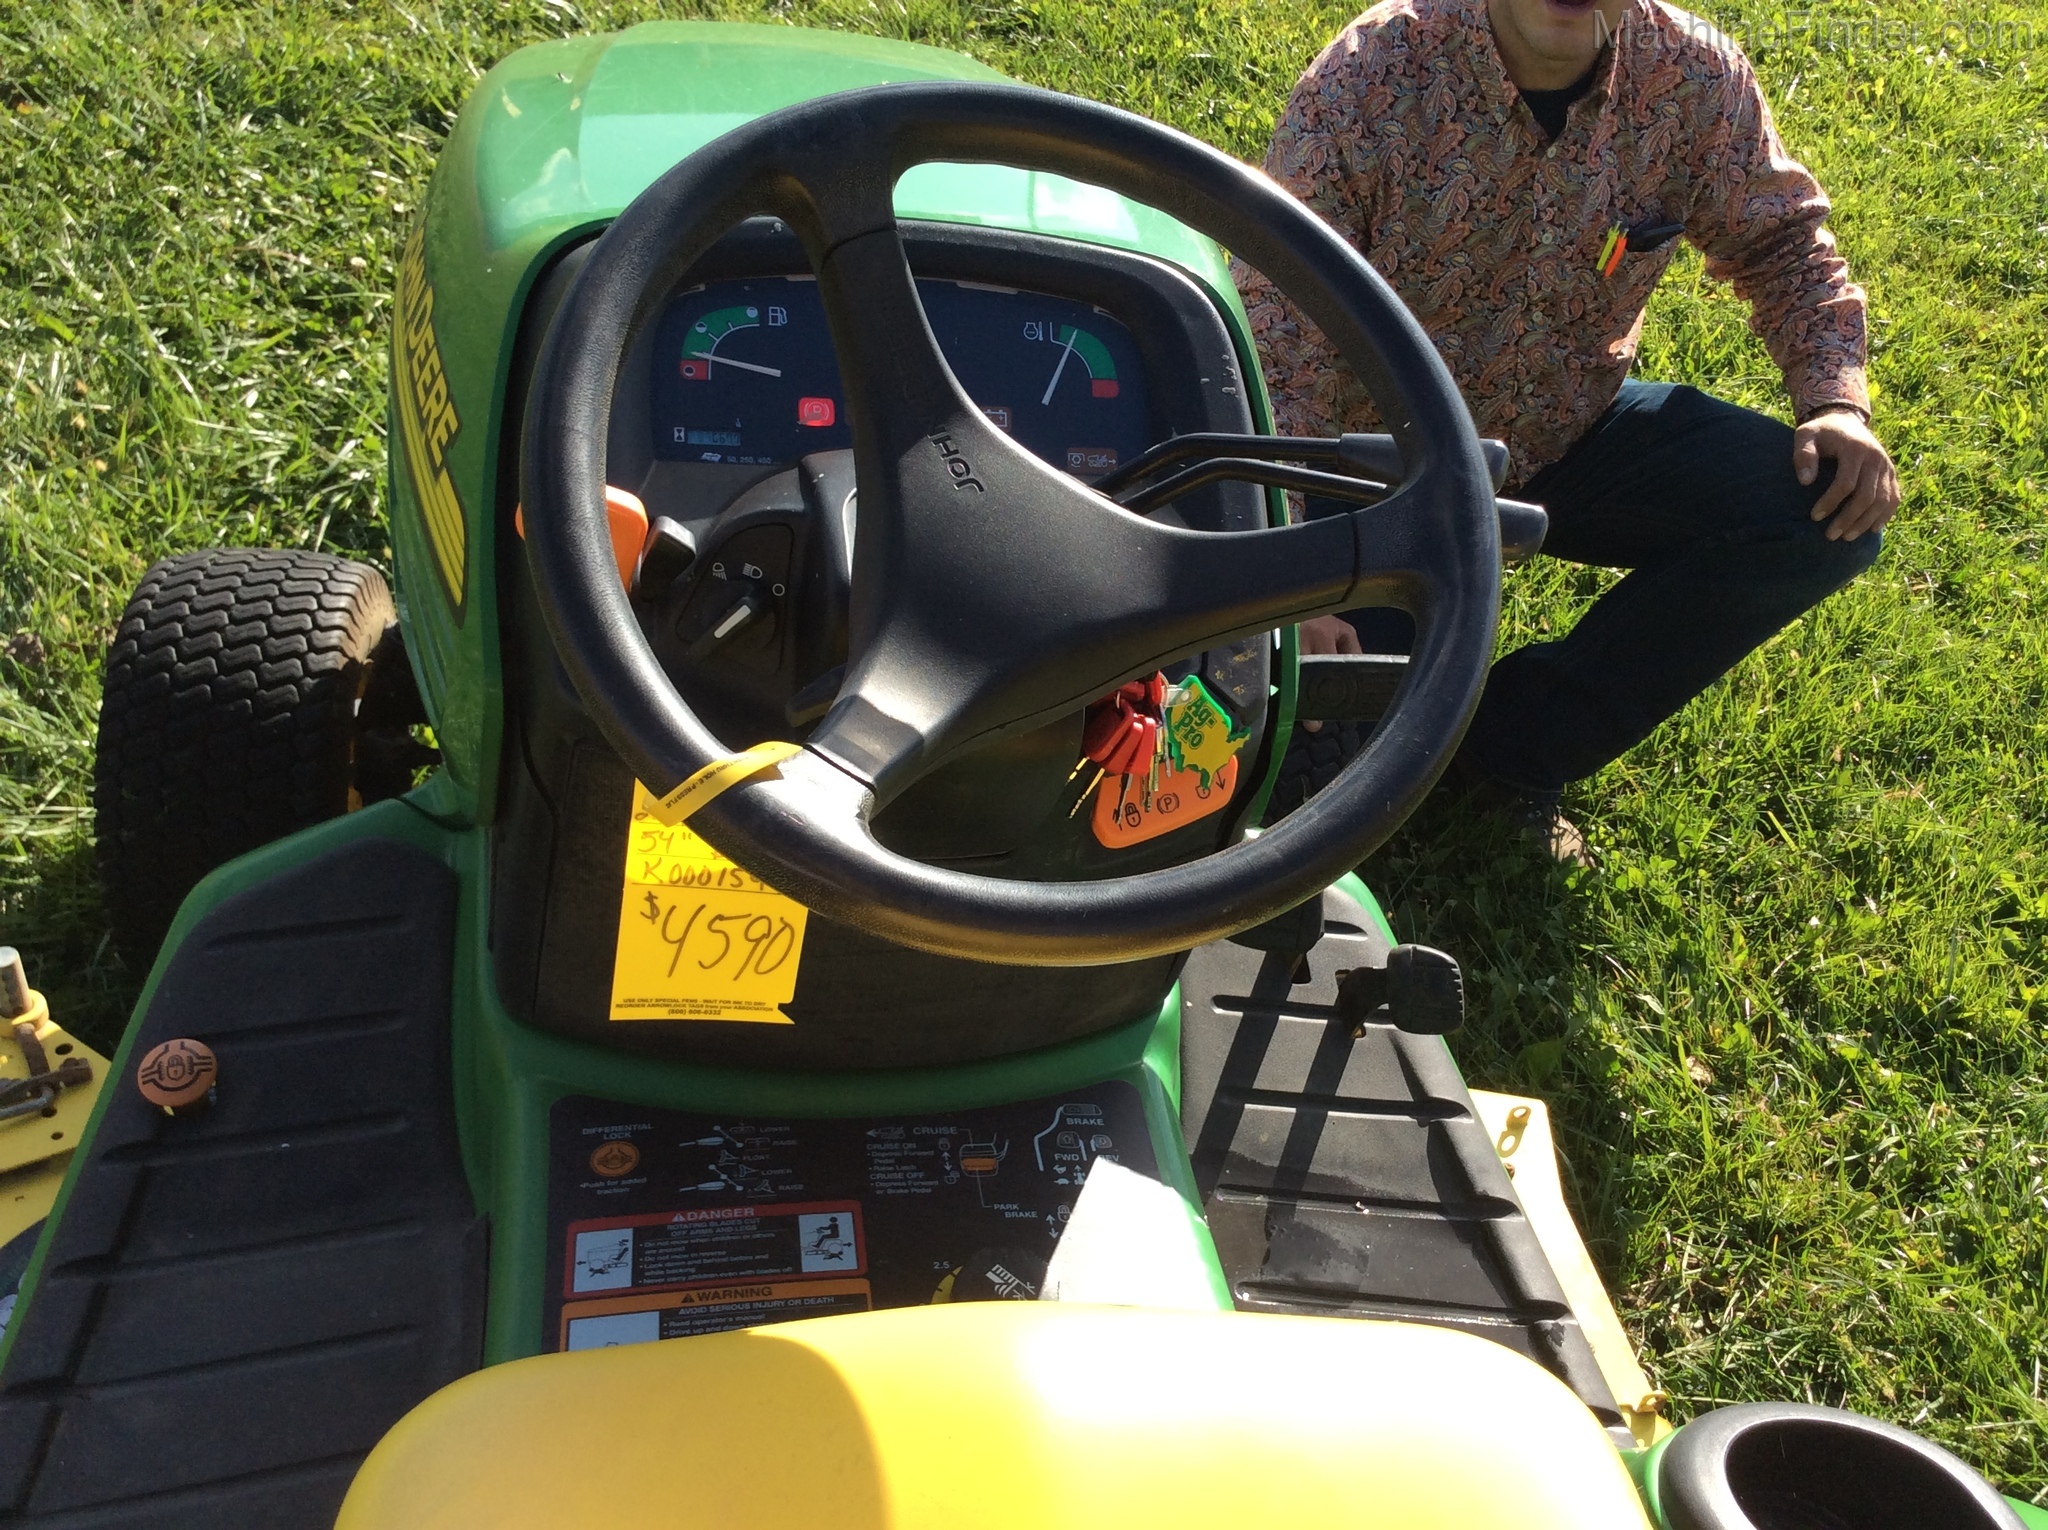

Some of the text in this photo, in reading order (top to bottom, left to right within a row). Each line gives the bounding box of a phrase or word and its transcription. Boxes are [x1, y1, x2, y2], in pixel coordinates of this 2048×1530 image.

[408, 285, 459, 469] DEERE
[1173, 712, 1206, 750] Pro
[640, 890, 795, 982] $4590
[1066, 1117, 1105, 1126] BRAKE
[582, 1123, 654, 1135] DIFFERENTIAL
[912, 1126, 959, 1135] CRUISE
[603, 1132, 632, 1140] LOCK
[1054, 1153, 1080, 1161] FWD
[761, 1168, 793, 1176] LOWER
[906, 1171, 926, 1179] OFF
[687, 1207, 755, 1221] DANGER
[1004, 1210, 1039, 1218] BRAKE
[667, 1221, 708, 1231] ROTATING
[709, 1219, 743, 1229] BLADES
[715, 1226, 734, 1234] AND
[932, 1261, 951, 1270] 2.5
[697, 1286, 773, 1302] WARNING
[678, 1296, 835, 1316] AVOID SERIOUS INJURY OR DEATH
